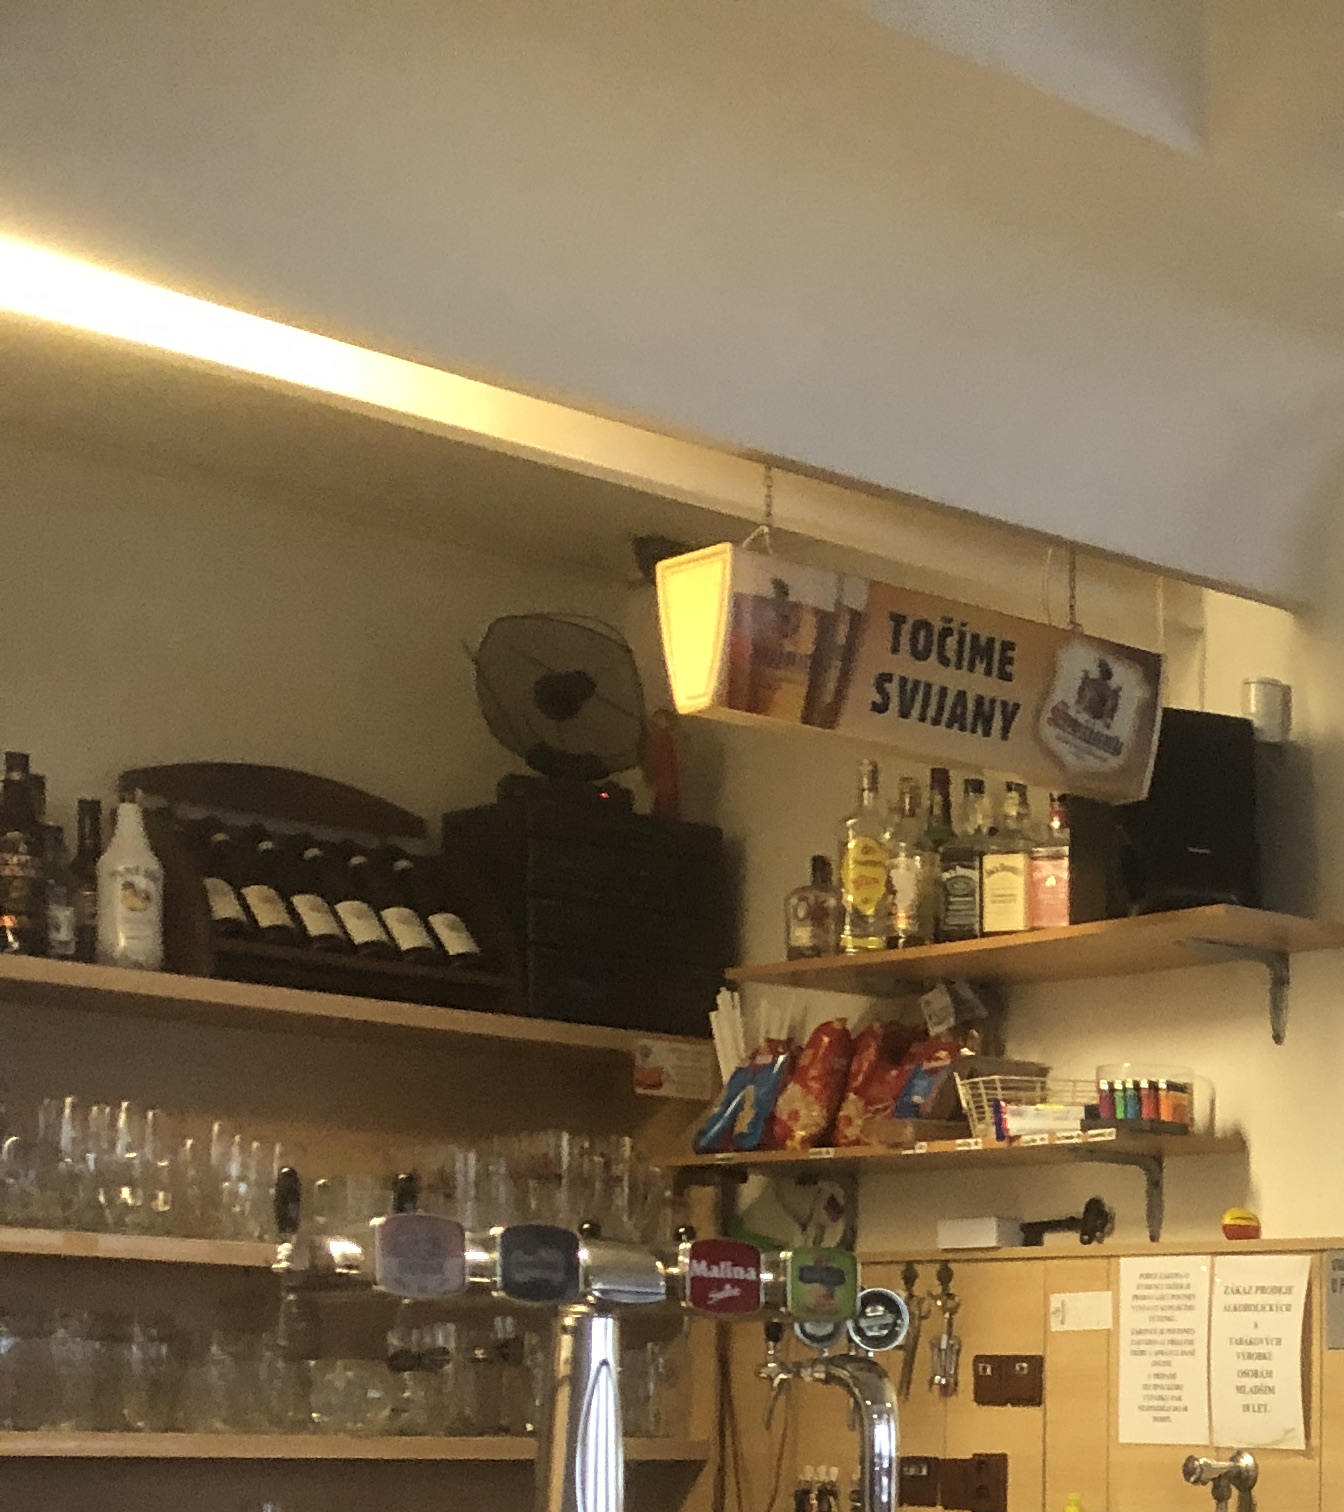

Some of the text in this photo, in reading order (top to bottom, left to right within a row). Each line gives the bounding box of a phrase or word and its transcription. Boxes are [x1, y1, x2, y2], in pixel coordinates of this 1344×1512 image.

[889, 610, 1016, 682] TOČÍME
[870, 672, 1021, 741] SVIJANY
[690, 1259, 757, 1282] Malina
